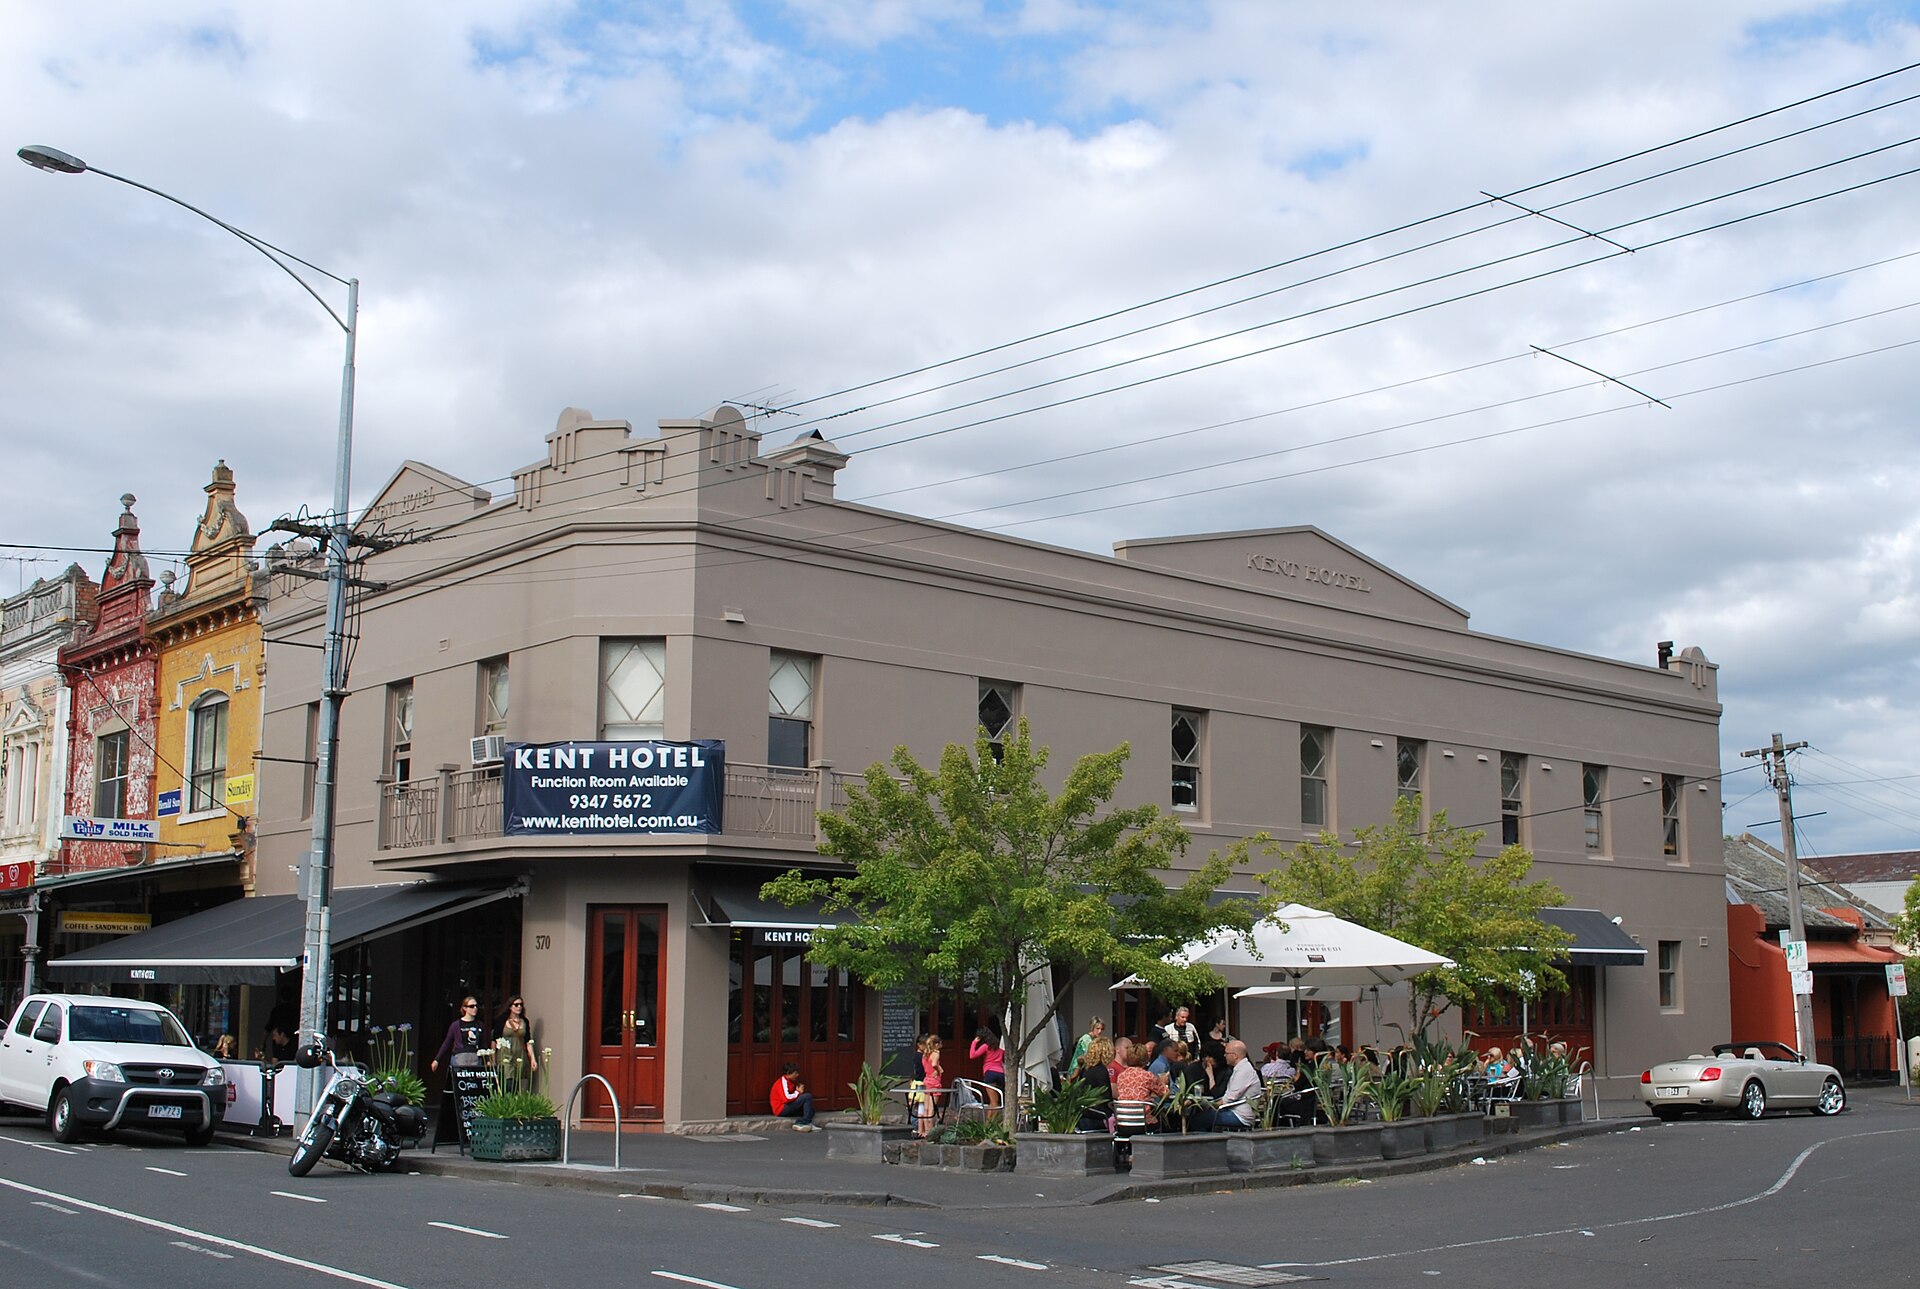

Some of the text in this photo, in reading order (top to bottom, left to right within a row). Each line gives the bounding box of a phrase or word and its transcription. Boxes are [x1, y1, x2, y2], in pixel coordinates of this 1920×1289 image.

[1246, 552, 1372, 593] KENT HOTEL
[514, 747, 705, 769] KENT HOTEL
[227, 780, 252, 797] Sunday
[531, 775, 688, 788] Function Room Available
[569, 794, 651, 809] 9347 5672
[76, 823, 101, 834] Pauls
[112, 822, 150, 831] MILK
[522, 814, 698, 829] www.kenthotel.com.au
[64, 922, 88, 930] COFFEE
[95, 923, 128, 931] SANDWICH
[535, 935, 551, 950] 370
[764, 931, 792, 942] KENT
